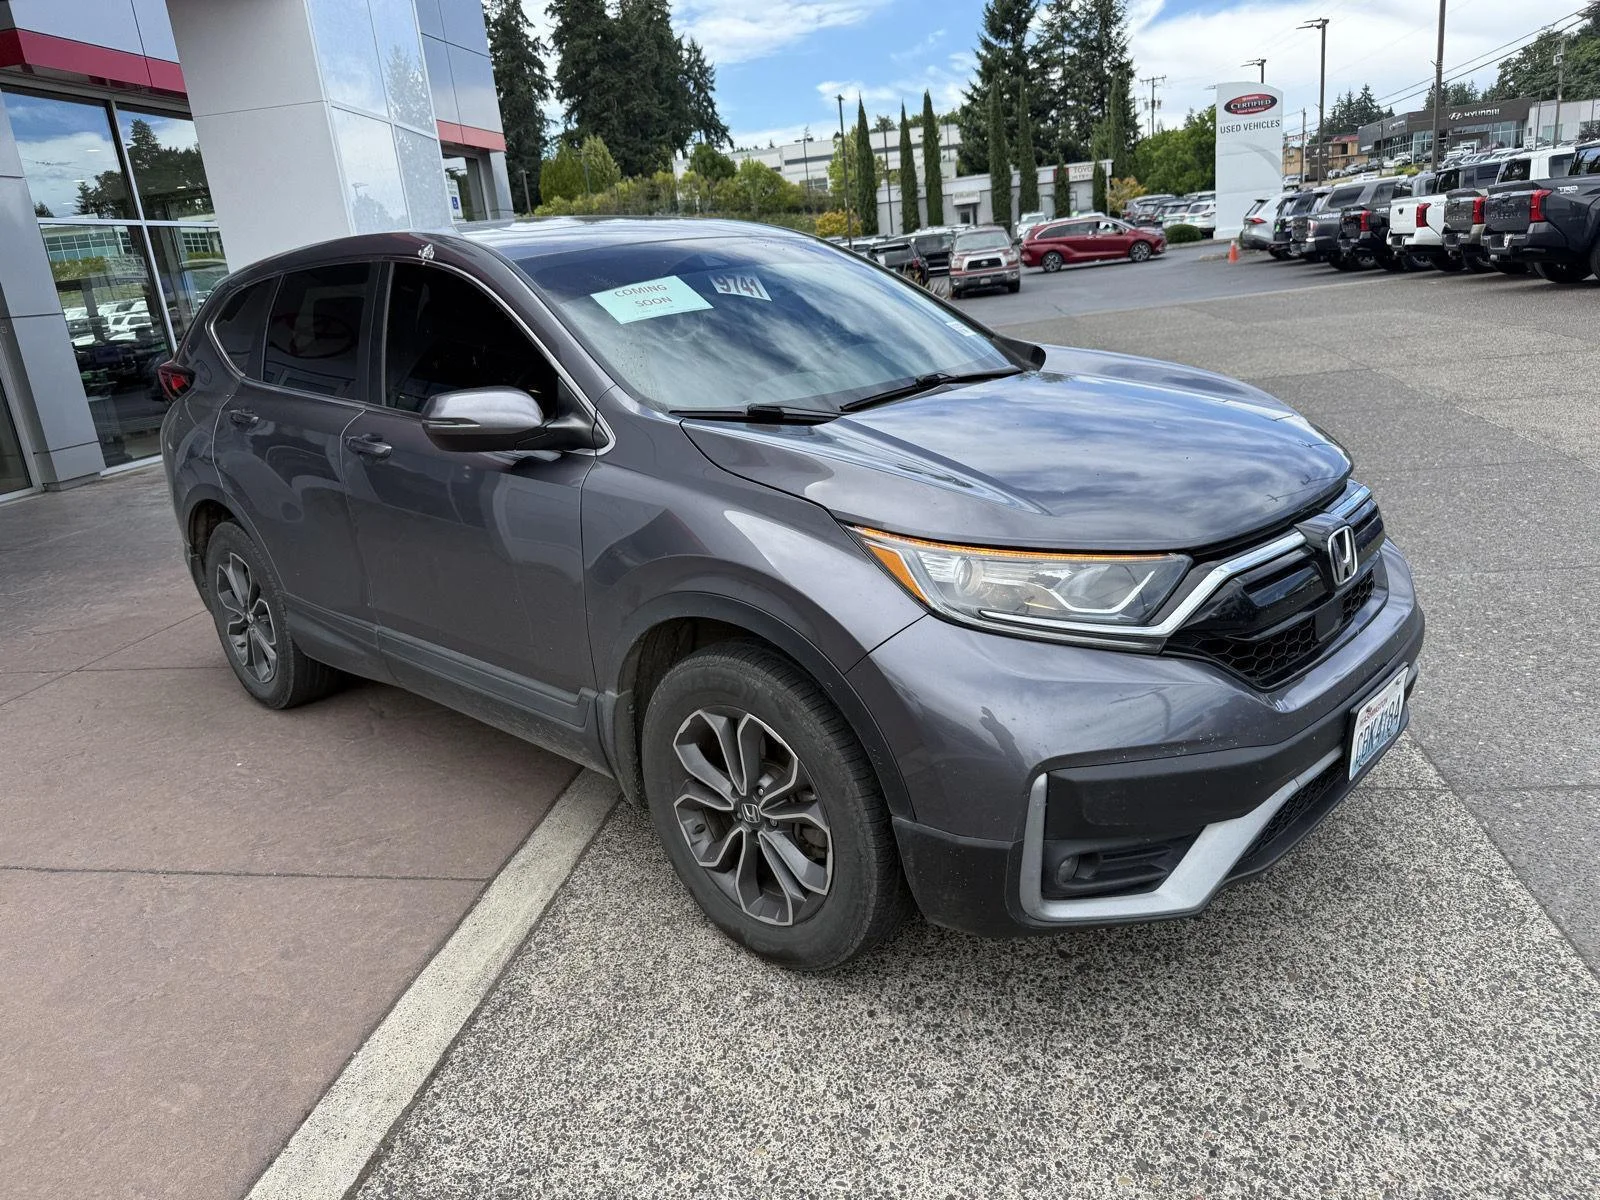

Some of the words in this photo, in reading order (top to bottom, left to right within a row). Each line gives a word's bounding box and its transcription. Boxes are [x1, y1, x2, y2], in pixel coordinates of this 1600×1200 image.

[1230, 99, 1271, 110] CERTIFIED
[1220, 124, 1242, 134] USED
[1243, 119, 1280, 131] VEHICLES
[614, 284, 668, 298] COMING
[713, 274, 765, 298] 9741
[634, 296, 673, 308] SOON
